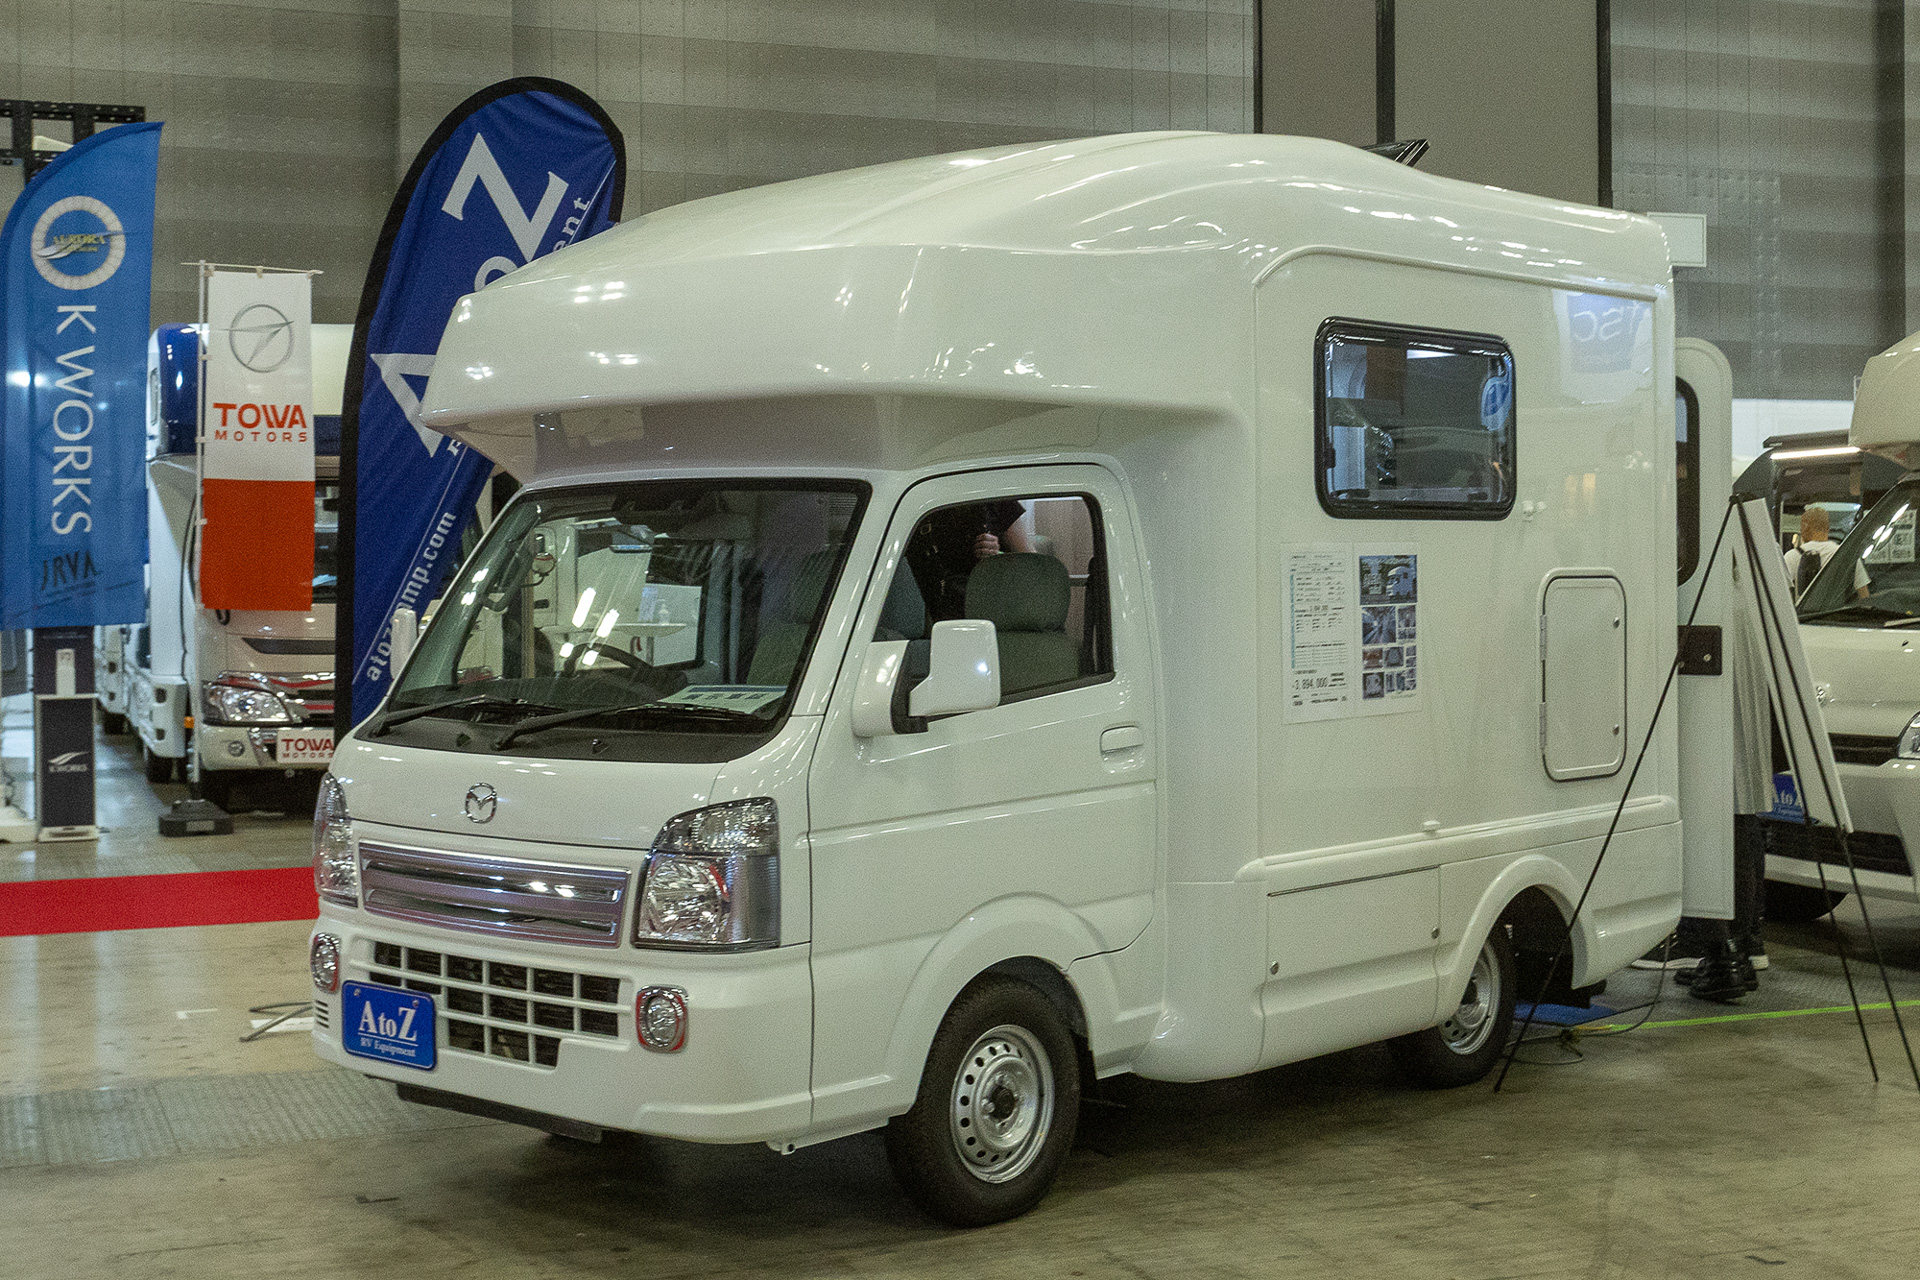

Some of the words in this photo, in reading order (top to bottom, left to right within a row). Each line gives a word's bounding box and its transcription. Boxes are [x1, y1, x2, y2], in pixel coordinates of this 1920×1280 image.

[213, 402, 307, 429] TOWA
[52, 345, 95, 535] WORKS
[215, 430, 307, 442] MOTORS
[281, 738, 334, 751] TOWA
[358, 1001, 417, 1041] AtoZ
